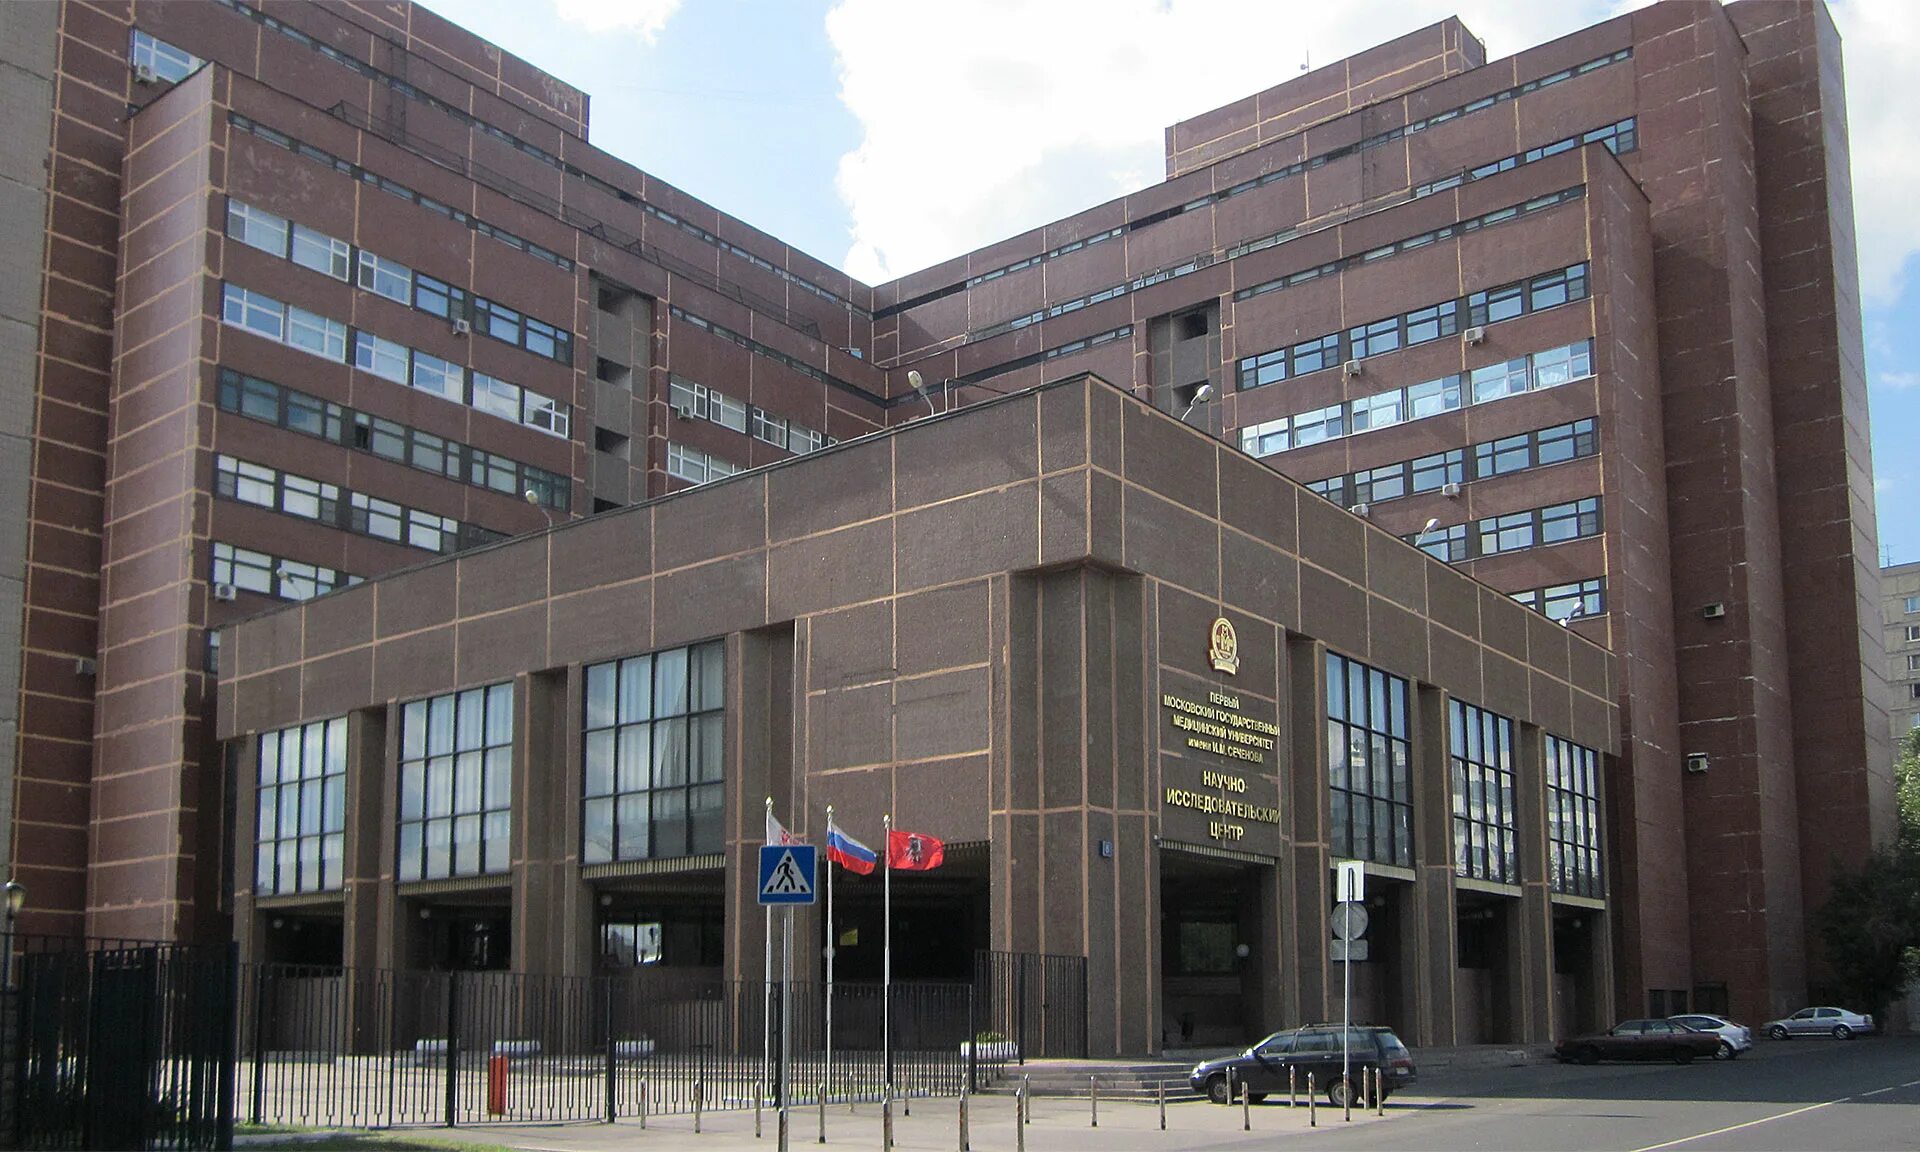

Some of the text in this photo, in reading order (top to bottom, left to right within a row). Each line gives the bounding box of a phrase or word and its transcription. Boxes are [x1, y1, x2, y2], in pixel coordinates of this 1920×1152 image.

[1164, 694, 1215, 720] МОСКОВСКИЙ
[1210, 691, 1240, 709] ПЕРВЫЙ
[1173, 714, 1273, 750] МЕДИЦИНСКИЙ УНИВЕРСИТЕТ
[1188, 738, 1211, 751] имени
[1228, 746, 1264, 763] СЕЧЕНОВА
[1203, 770, 1249, 793] НАУЧНО-
[1210, 821, 1244, 840] ЦЕНТР
